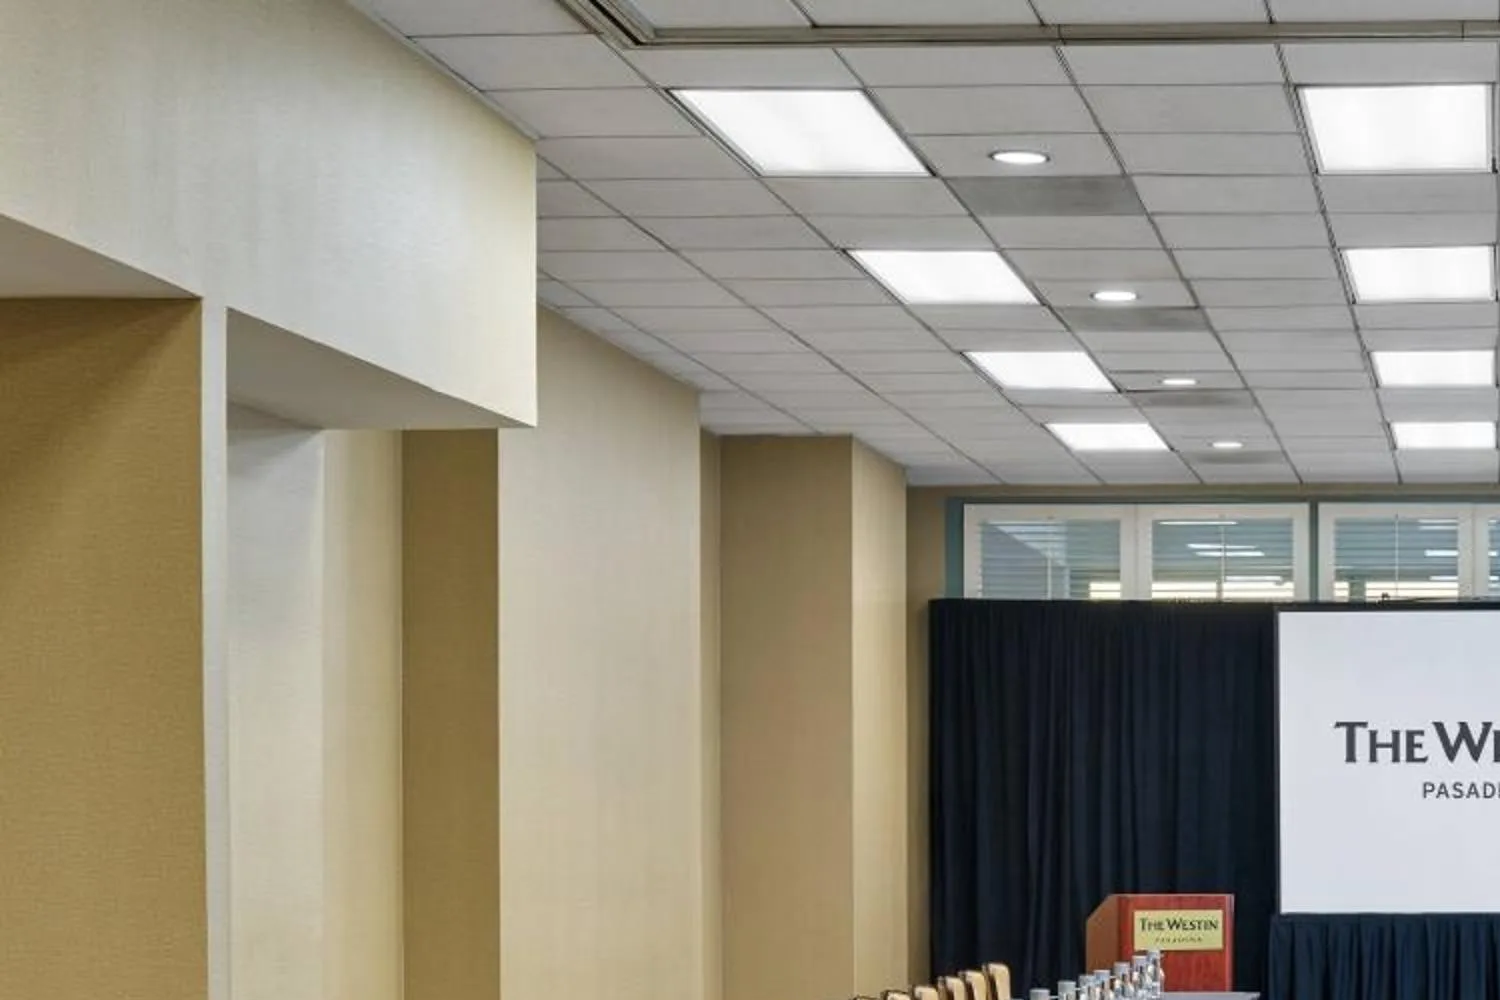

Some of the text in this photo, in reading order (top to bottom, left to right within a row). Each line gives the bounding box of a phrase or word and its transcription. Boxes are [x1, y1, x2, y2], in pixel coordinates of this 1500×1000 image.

[1334, 721, 1429, 764] THE
[1140, 917, 1219, 931] THE WESTIN
